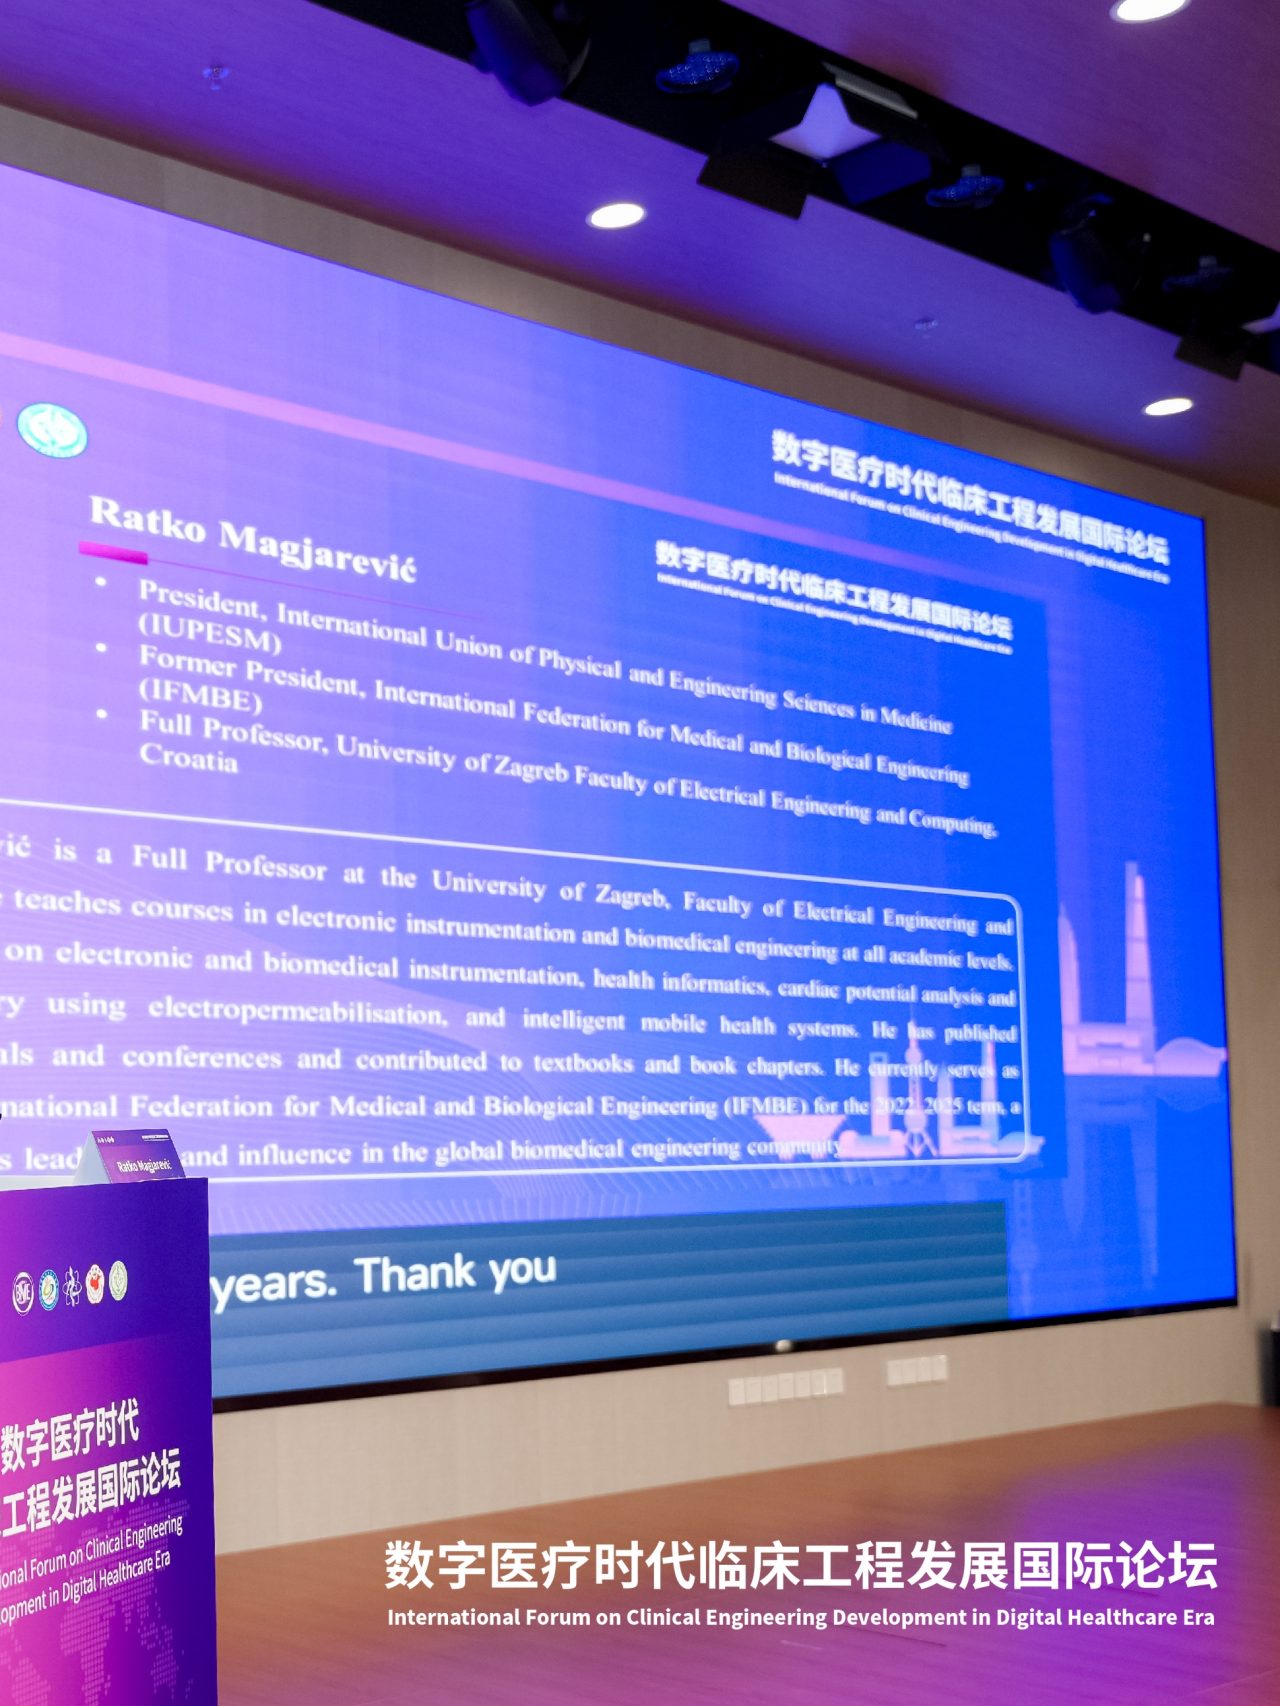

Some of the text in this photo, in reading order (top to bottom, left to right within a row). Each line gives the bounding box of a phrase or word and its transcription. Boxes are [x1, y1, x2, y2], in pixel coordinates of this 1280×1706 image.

[771, 428, 1170, 566] 数字医疗时代临床工程发展国际论坛
[774, 471, 850, 502] International
[850, 491, 886, 512] Forum
[89, 494, 418, 585] Ratko Magjarević
[137, 611, 282, 657] (IUPESM)
[139, 577, 954, 736] President, International Union of Physical and Engineering Sciences in Medicine
[138, 677, 263, 717] (IFMBE)
[140, 642, 970, 790] Former President, International Federation for Medical and Biological Engineering
[139, 741, 239, 775] Croatia
[140, 708, 998, 841] Full Professor, University of Zagreb Faculty of Electrical Engineering and Computing.
[53, 837, 78, 863] is
[95, 846, 113, 866] a
[132, 843, 188, 872] Full
[205, 850, 328, 882] Professor
[343, 865, 365, 886] at
[380, 864, 417, 890] the
[432, 868, 547, 904] University
[559, 881, 587, 903] of
[595, 882, 672, 911] Zagreb,
[683, 890, 752, 920] Faculty
[762, 897, 785, 918] of
[793, 899, 875, 926] Electrical
[882, 906, 979, 938] Engineering
[985, 918, 1014, 936] and
[13, 888, 123, 916] teaches
[130, 899, 234, 923] courses
[243, 901, 268, 926] in
[275, 904, 397, 934] electronic
[406, 912, 577, 945] instrumentation
[581, 925, 620, 947] and
[624, 926, 731, 954] biomedical
[734, 937, 840, 966] engineering
[843, 946, 860, 962] at
[864, 945, 887, 963] all
[890, 948, 963, 968] academic
[967, 951, 1014, 972] levels.
[3, 943, 44, 963] on
[55, 940, 193, 970] electronic
[204, 948, 253, 973] and
[263, 949, 399, 979] biomedical
[409, 957, 586, 989] instrumentation,
[593, 966, 656, 991] health
[662, 970, 772, 997] informatics,
[777, 978, 840, 1000] cardiac
[846, 984, 919, 1004] potential
[921, 986, 985, 1009] analysis
[988, 990, 1017, 1008] and
[47, 990, 128, 1023] using
[147, 994, 449, 1029] electropermeabilisation,
[465, 1006, 506, 1029] and
[523, 1007, 626, 1036] intelligent
[640, 1012, 708, 1035] mobile
[719, 1014, 777, 1036] health
[787, 1020, 859, 1042] systems.
[872, 1019, 898, 1041] He
[907, 1019, 936, 1041] has
[944, 1023, 1019, 1045] published
[116, 1160, 138, 1173] Ratko
[210, 1252, 556, 1314] years. Thank you
[0, 1397, 139, 1475] 数字医疗时代
[30, 1551, 67, 1577] Forum
[69, 1547, 83, 1567] on
[85, 1532, 124, 1561] Clinical
[126, 1514, 183, 1549] Engineering
[49, 1586, 59, 1608] in
[62, 1571, 97, 1604] Digital
[99, 1559, 153, 1590] Healthcare
[155, 1549, 171, 1570] Era
